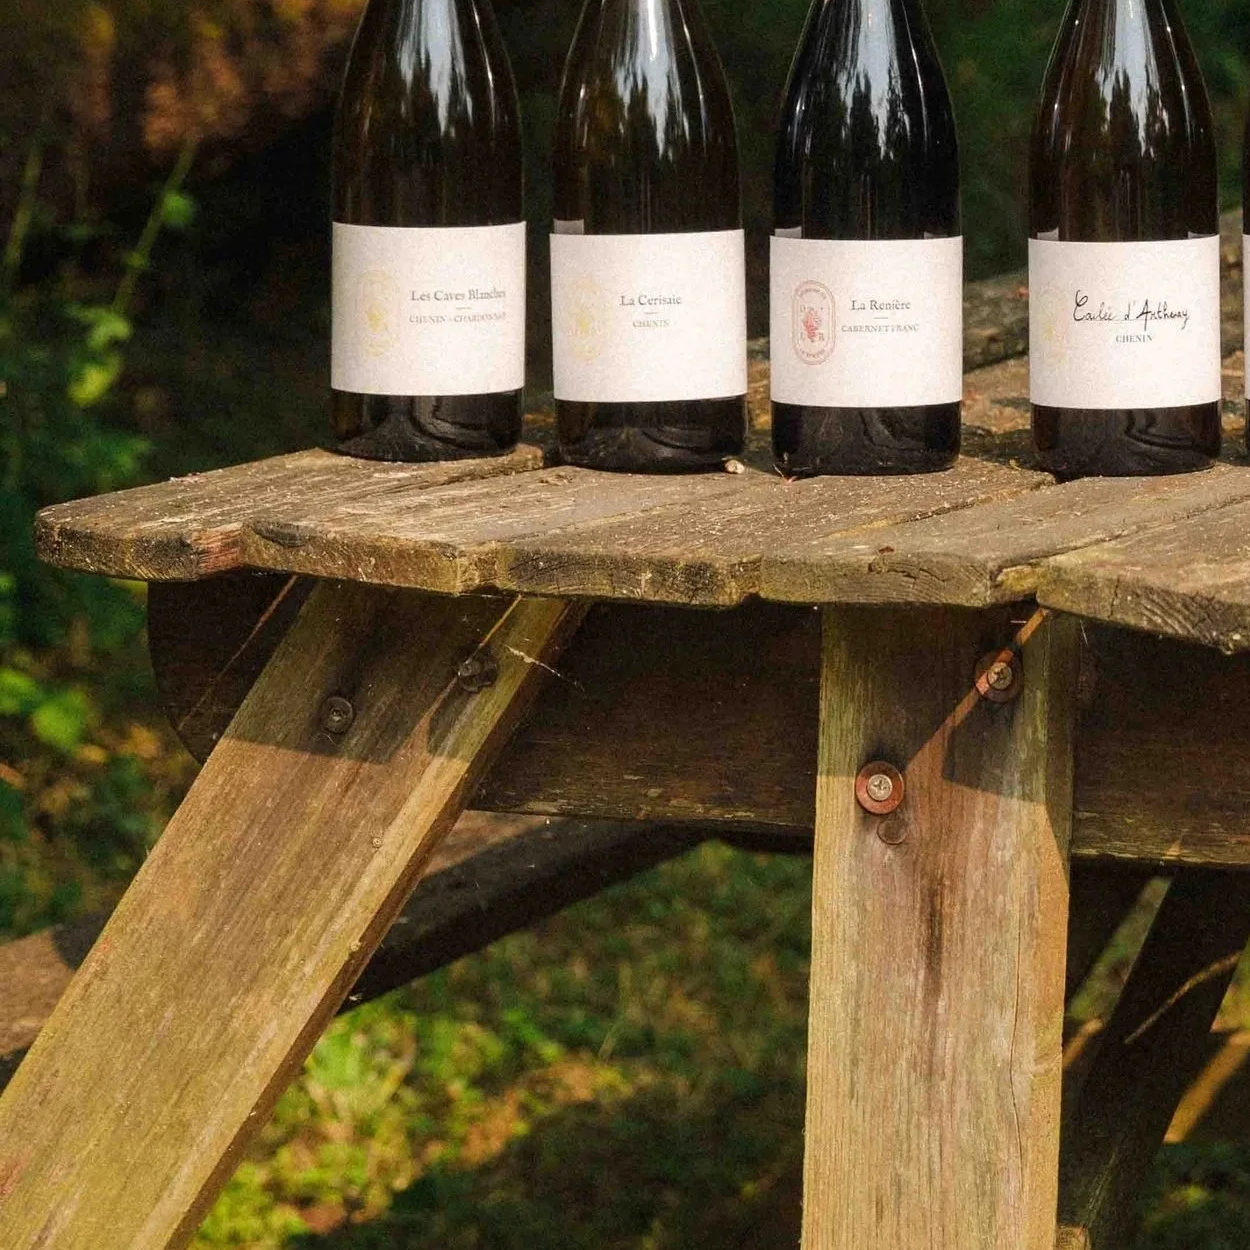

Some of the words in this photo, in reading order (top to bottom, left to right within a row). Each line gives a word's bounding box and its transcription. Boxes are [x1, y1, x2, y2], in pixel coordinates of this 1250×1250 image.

[409, 289, 431, 302] Les
[433, 289, 466, 302] Caves
[619, 295, 635, 307] La
[638, 293, 683, 306] Cerisaie
[851, 299, 866, 311] La
[869, 298, 911, 311] Renière
[841, 324, 890, 333] CABERNET
[891, 324, 920, 333] FRANC
[1115, 334, 1153, 344] CHENIN
